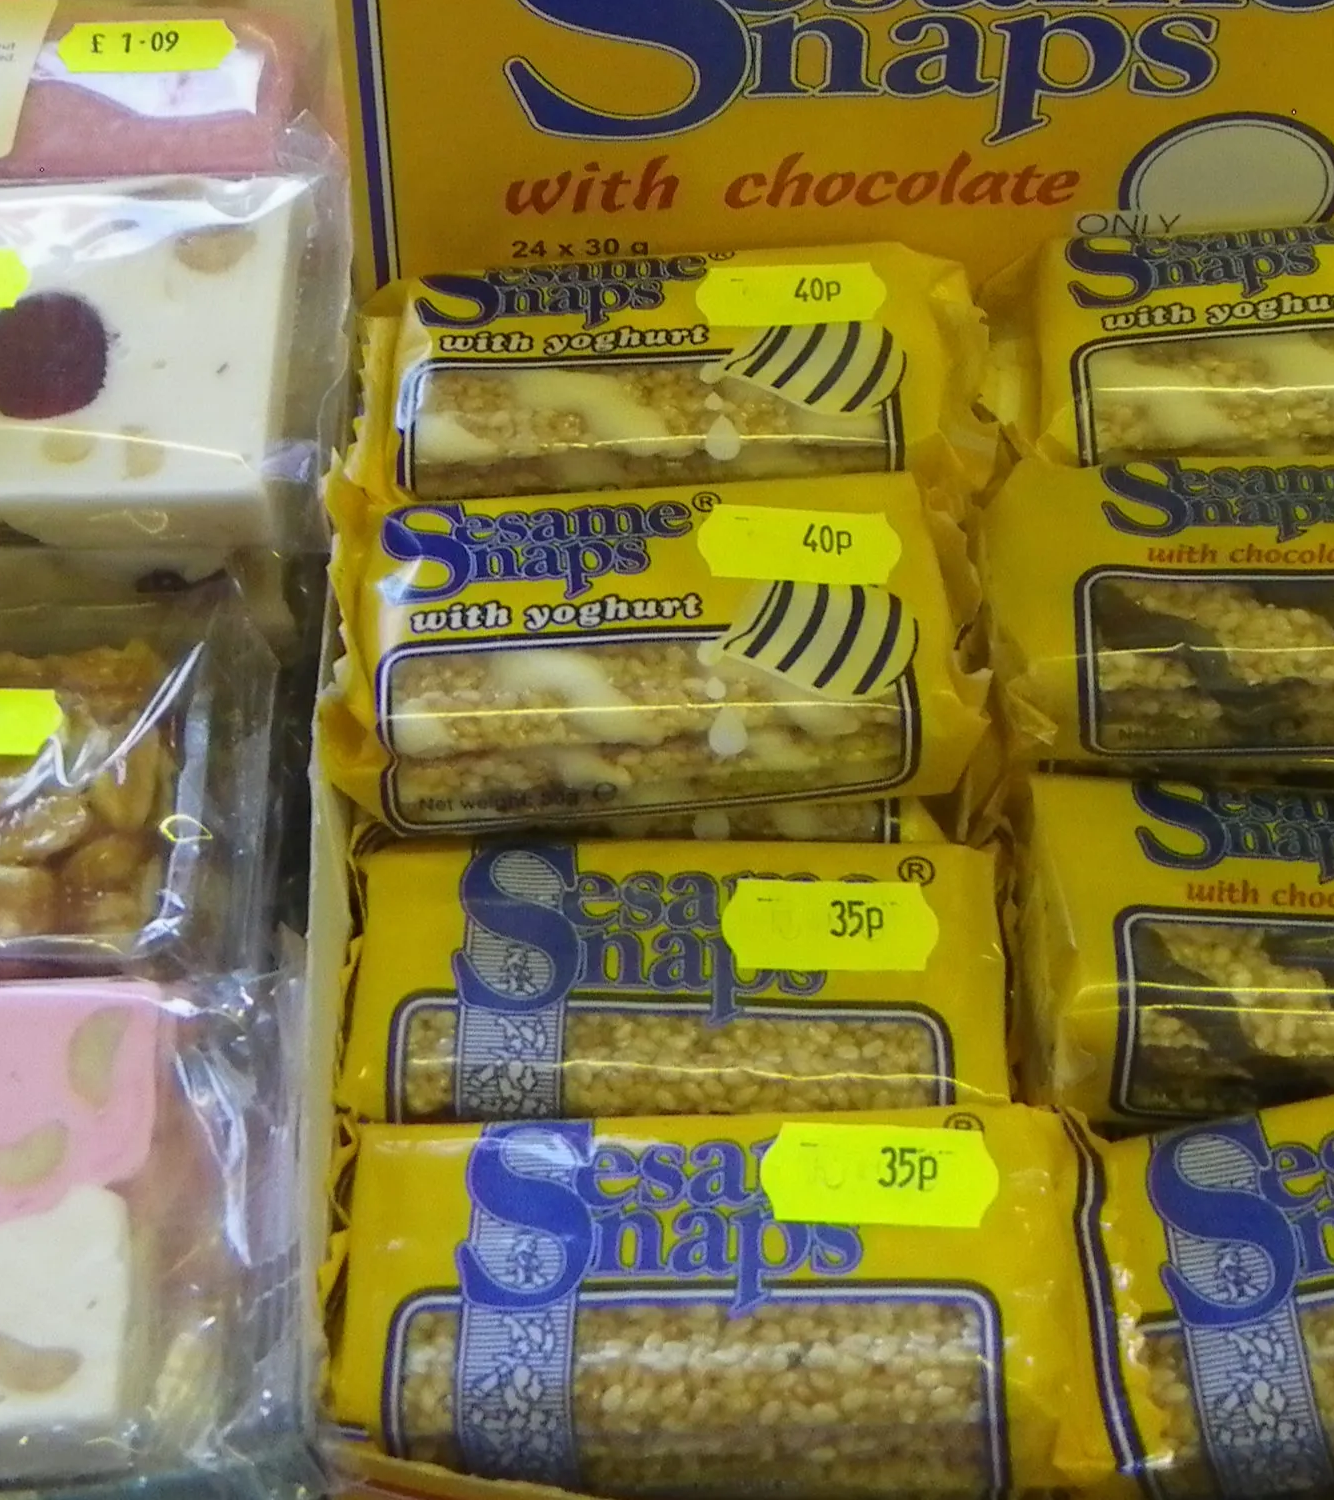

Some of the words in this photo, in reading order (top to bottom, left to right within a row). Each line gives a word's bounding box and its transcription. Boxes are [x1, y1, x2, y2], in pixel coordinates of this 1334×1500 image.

[503, 8, 1223, 148] Snaps
[504, 153, 709, 218] with
[722, 150, 1083, 213] chocolate
[1074, 212, 1183, 238] ONLY
[511, 238, 545, 258] 24
[558, 243, 574, 258] x
[585, 237, 621, 257] 30
[793, 276, 843, 304] 40p
[1067, 245, 1320, 309] Snaps
[420, 272, 666, 330] Snaps
[1101, 303, 1195, 333] with
[439, 330, 534, 353] with
[541, 324, 711, 355] yoghurt
[381, 496, 694, 550] Sesame
[801, 522, 853, 554] 40p
[381, 534, 651, 605] Snaps
[1146, 543, 1220, 565] with
[409, 602, 512, 633] with
[523, 593, 704, 631] yoghurt
[1185, 880, 1261, 906] with
[829, 899, 885, 940] 35p
[877, 1146, 938, 1191] 35p
